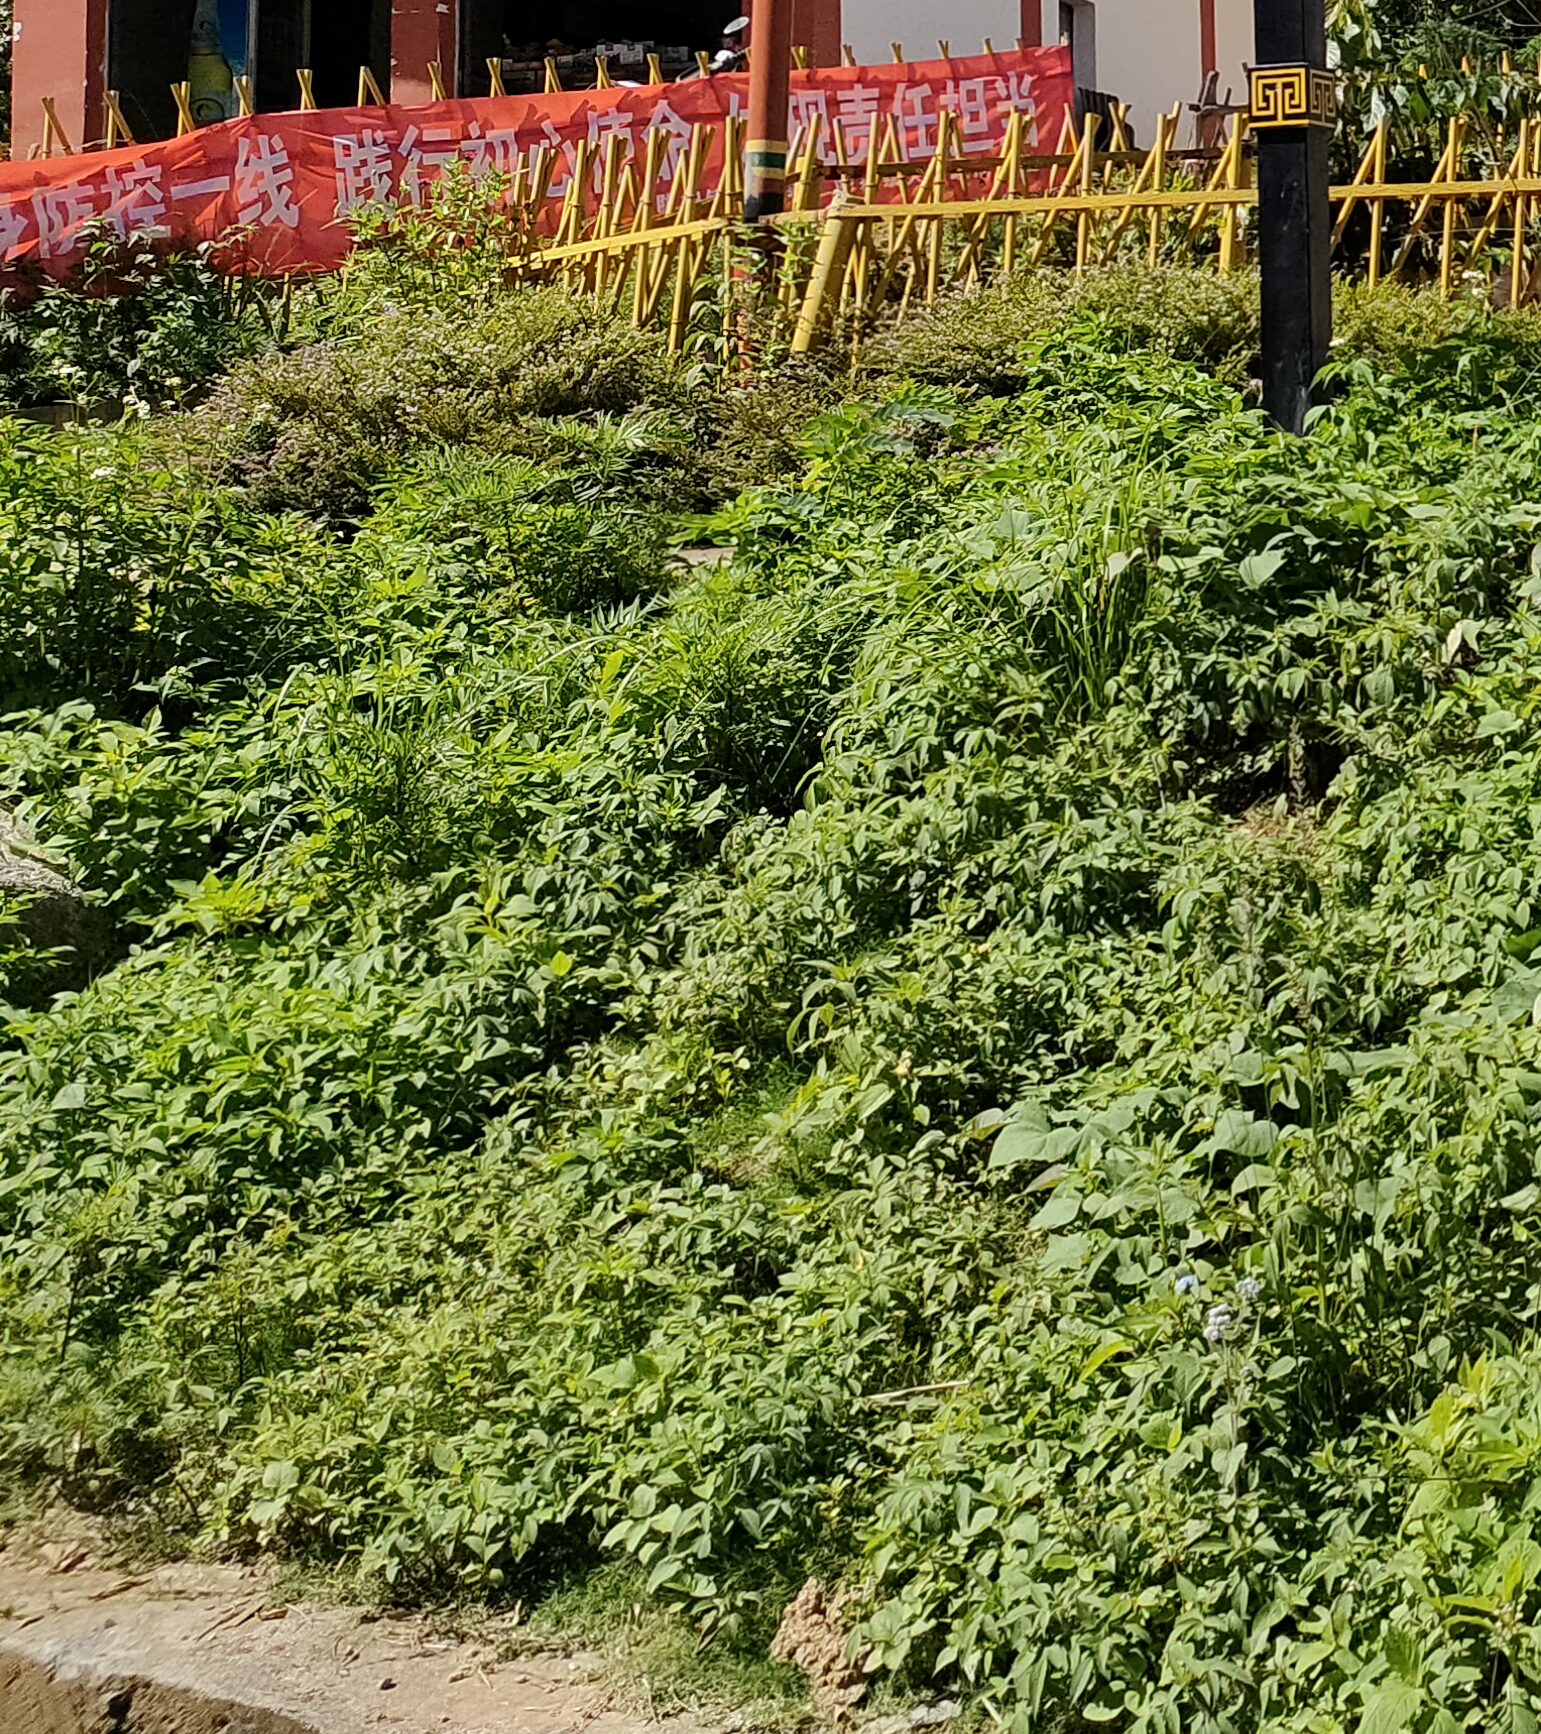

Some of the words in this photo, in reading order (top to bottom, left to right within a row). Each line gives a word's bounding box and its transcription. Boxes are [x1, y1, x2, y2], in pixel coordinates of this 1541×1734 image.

[729, 71, 1038, 167] 现责任担当
